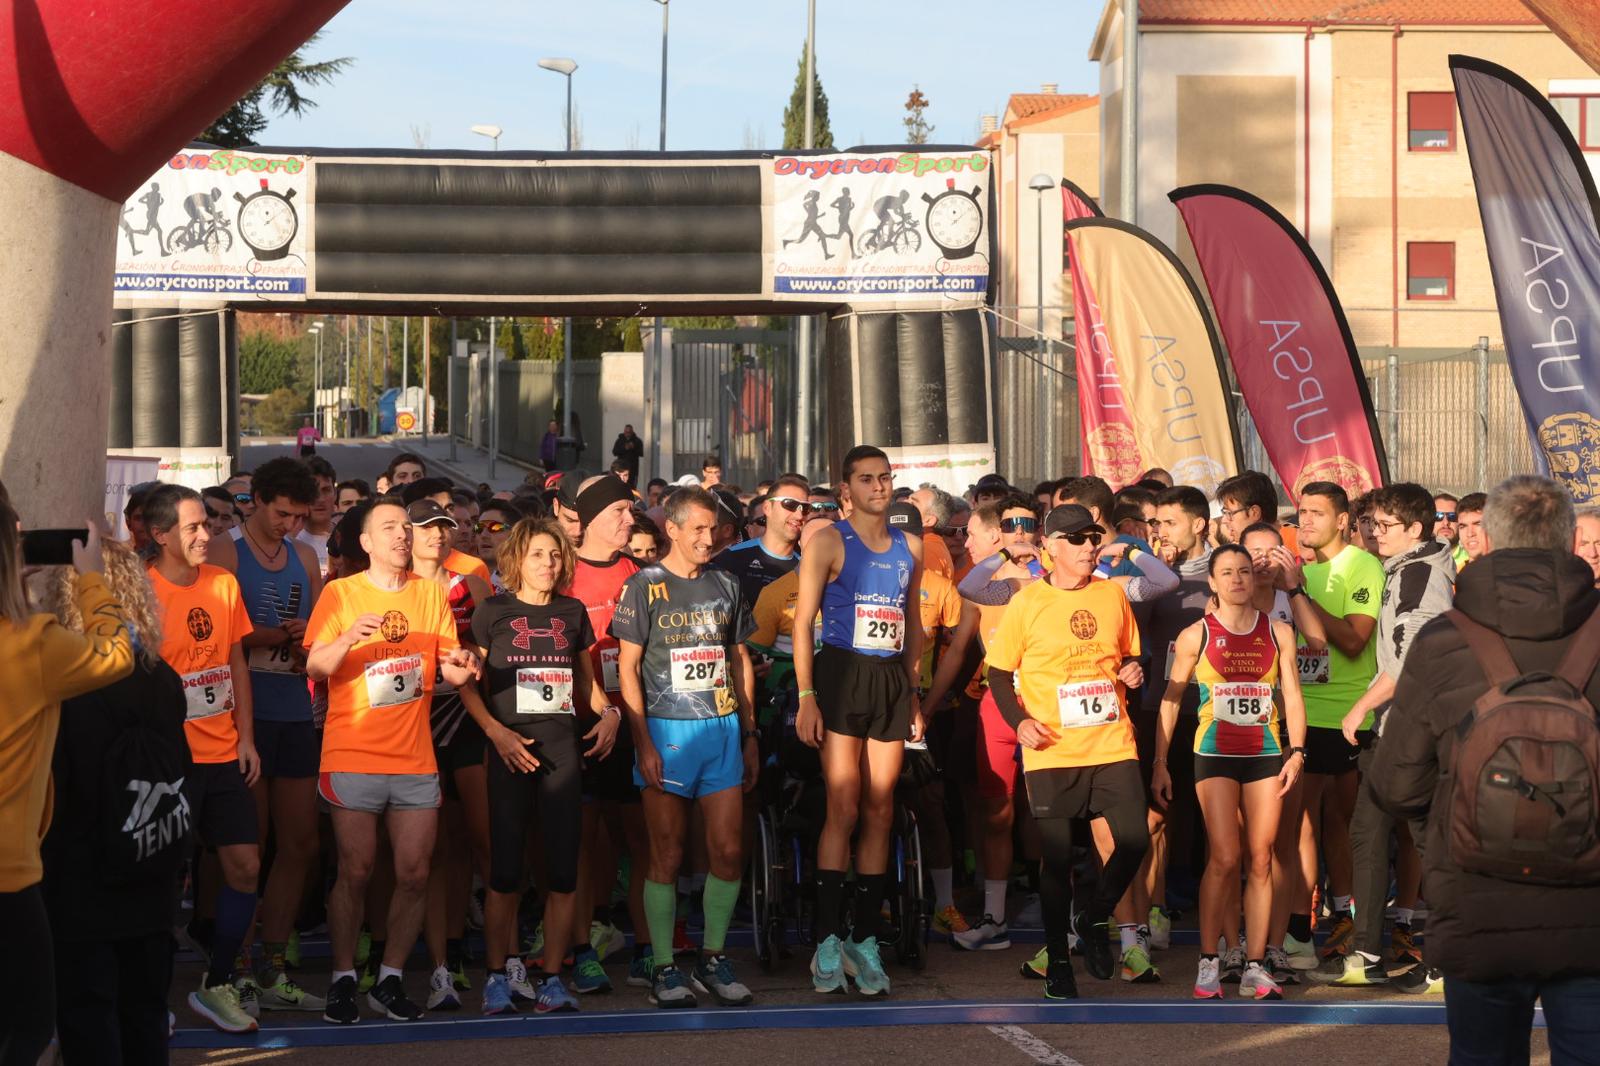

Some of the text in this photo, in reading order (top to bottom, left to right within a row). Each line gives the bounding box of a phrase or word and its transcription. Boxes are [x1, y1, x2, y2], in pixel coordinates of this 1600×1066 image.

[168, 150, 305, 176] onSport
[774, 153, 989, 180] OrycronSport
[114, 276, 289, 292] ww.orycronsport.com
[790, 276, 976, 293] www.orycronsport.com
[867, 621, 897, 640] 293
[187, 644, 218, 662] UPSA
[507, 655, 537, 663] UNDER
[671, 649, 725, 663] bedunia
[1069, 643, 1105, 657] UPSA
[684, 662, 716, 681] 287
[1297, 656, 1320, 674] 269
[393, 674, 405, 692] 3
[518, 671, 571, 682] bedunia
[204, 686, 216, 705] 5
[542, 684, 554, 701] 8
[1059, 683, 1114, 699] bedunia
[1215, 685, 1271, 697] bedunia
[1080, 697, 1103, 715] 16
[1227, 698, 1261, 716] 158
